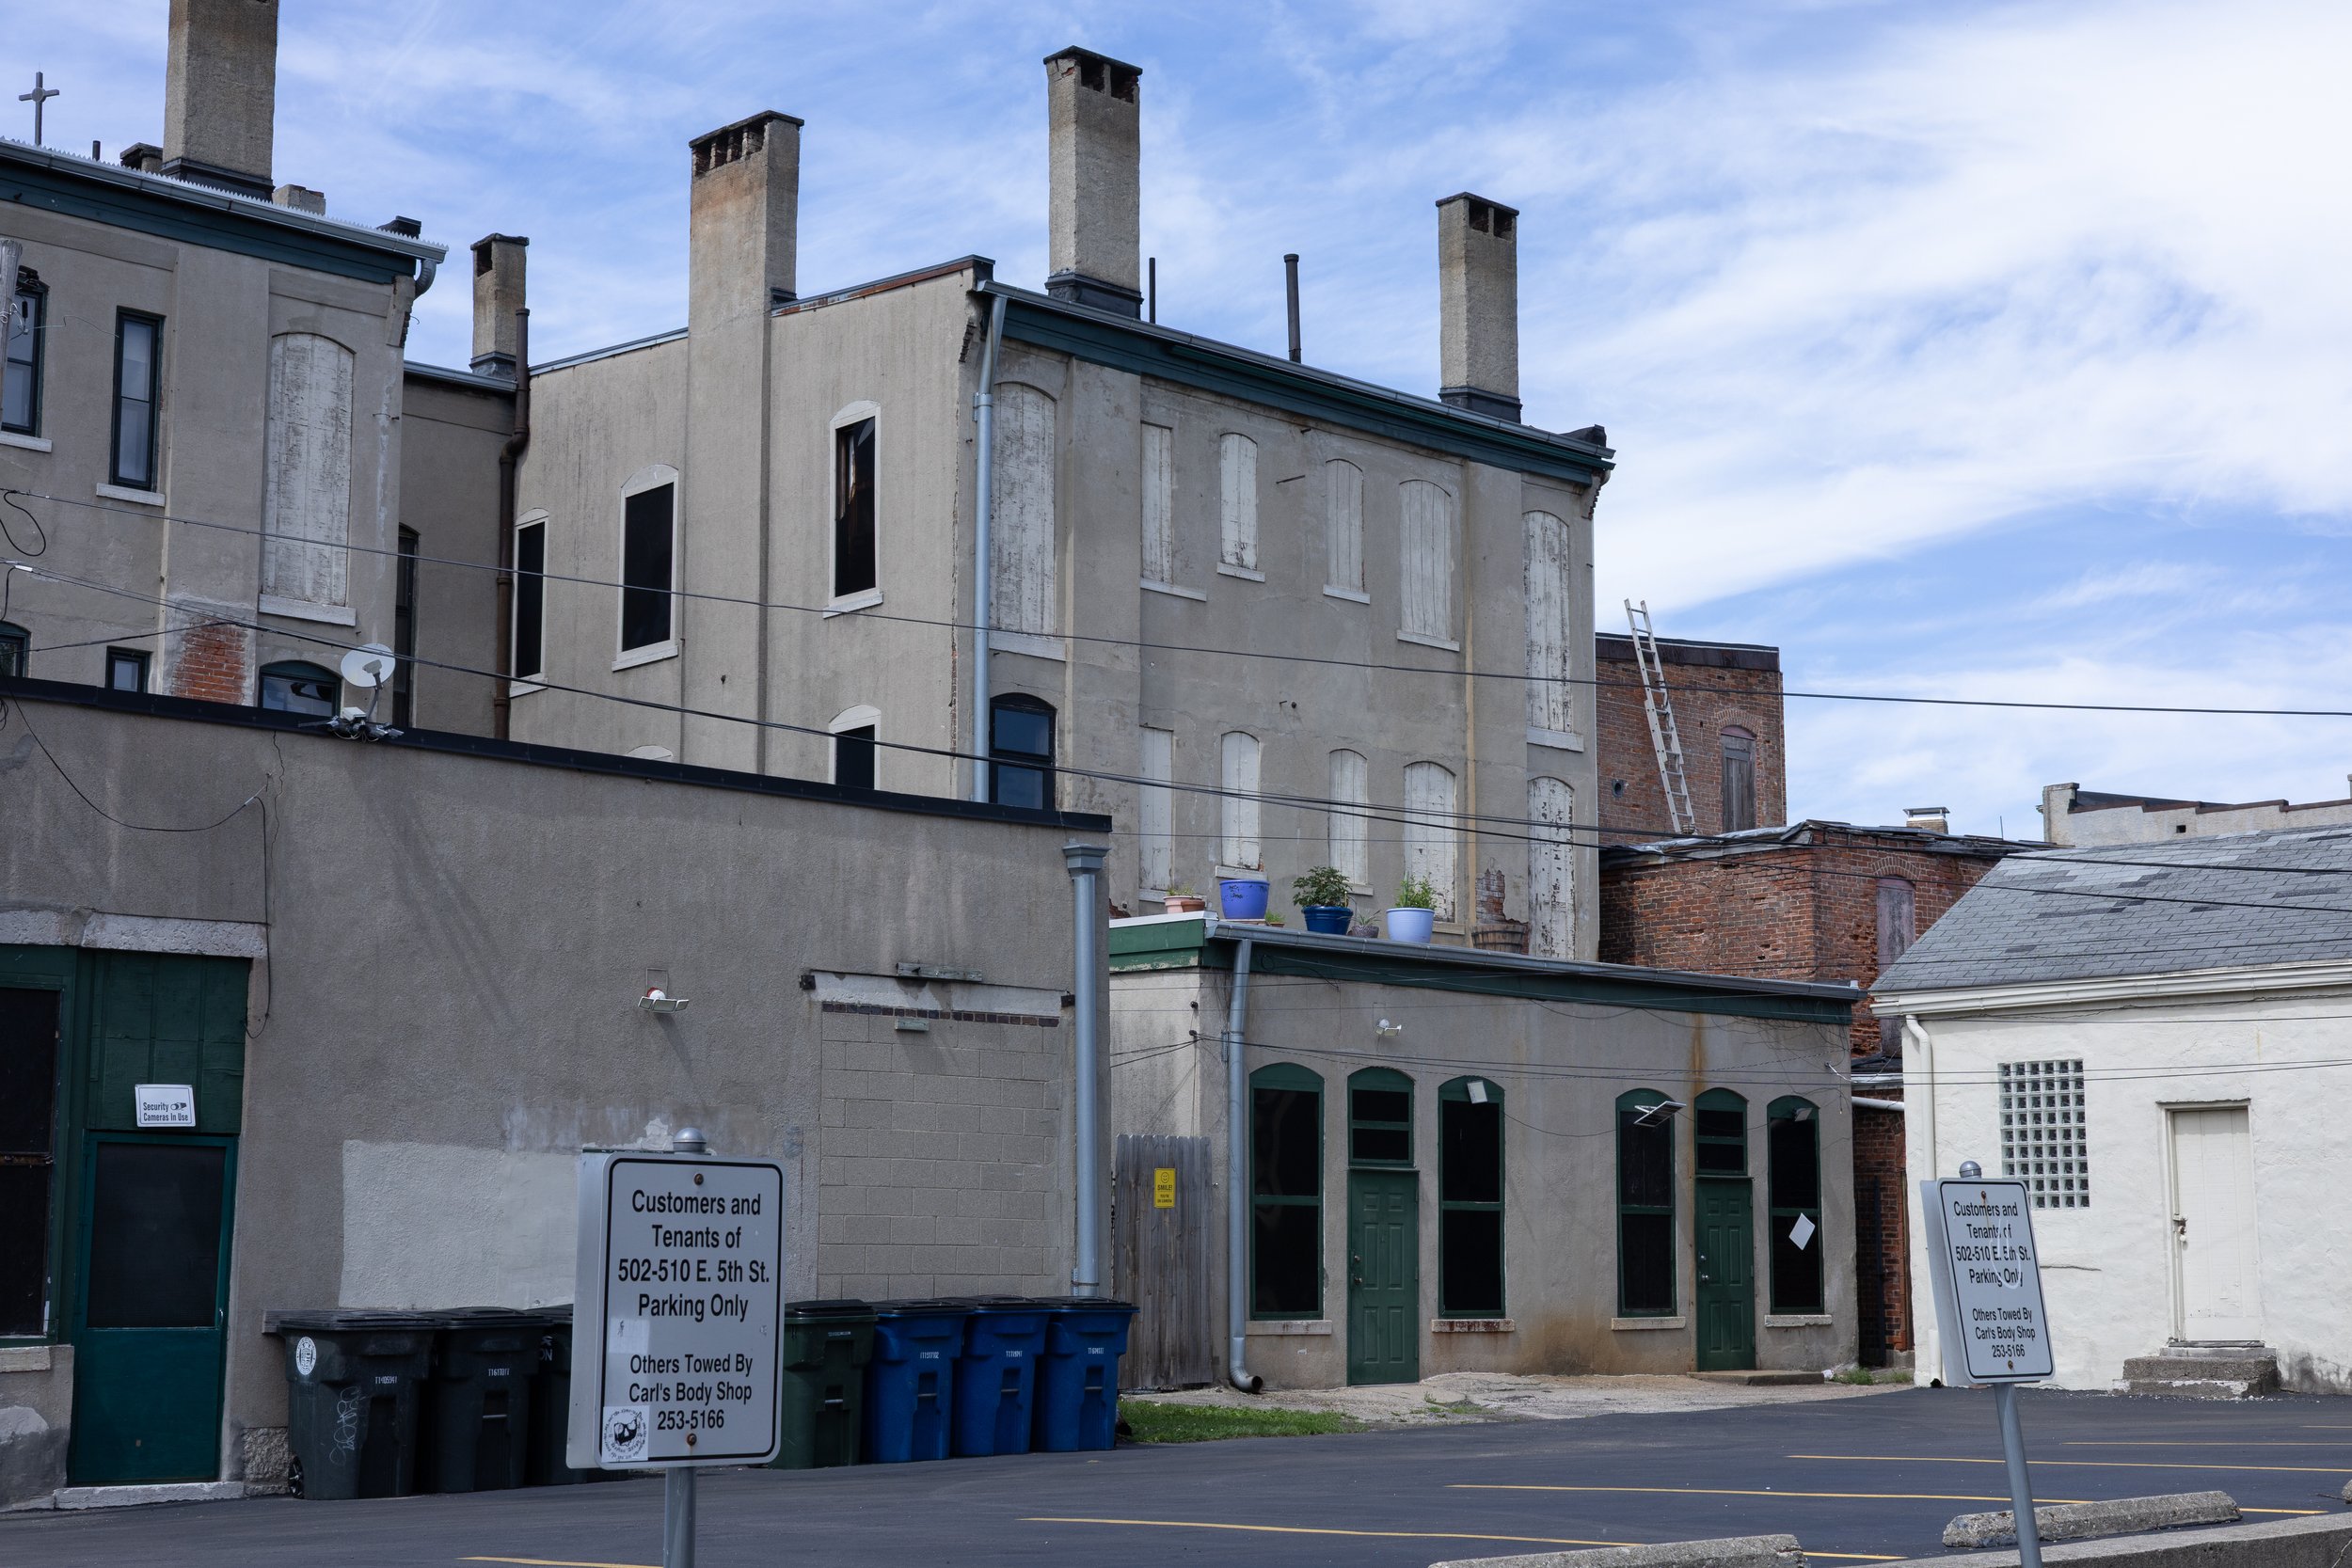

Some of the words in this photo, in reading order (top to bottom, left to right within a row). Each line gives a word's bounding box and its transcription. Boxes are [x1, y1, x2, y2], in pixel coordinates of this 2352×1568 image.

[143, 1102, 168, 1112] Security
[144, 1113, 168, 1121] Cameras
[171, 1113, 176, 1121] In
[178, 1113, 188, 1121] Use
[632, 1189, 725, 1215] Customers
[731, 1194, 761, 1215] and
[1953, 1200, 2000, 1217] Customers
[2002, 1202, 2018, 1216] and
[652, 1224, 720, 1248] Tenants
[724, 1226, 741, 1249] of
[1966, 1223, 2001, 1239] Tenants
[2003, 1224, 2011, 1239] of
[1955, 1246, 1991, 1261] 502-510
[1993, 1246, 2002, 1261] E.
[2003, 1245, 2017, 1260] 5th
[2018, 1245, 2031, 1260] St.
[618, 1259, 691, 1282] 502-510
[696, 1259, 711, 1283] E.
[717, 1260, 743, 1283] 5th
[749, 1260, 770, 1283] St.
[1969, 1268, 2002, 1287] Parking
[2004, 1268, 2023, 1287] Only
[639, 1293, 705, 1323] Parking
[710, 1292, 749, 1323] Only
[1972, 1308, 1997, 1323] Others
[1998, 1307, 2021, 1322] Towed
[2023, 1307, 2032, 1323] By
[1975, 1326, 1996, 1340] Carl's
[1997, 1326, 2016, 1341] Body
[2017, 1325, 2036, 1341] Shop
[1992, 1344, 2025, 1358] 253-5166
[630, 1354, 680, 1374] Others
[685, 1354, 731, 1373] Towed
[736, 1354, 753, 1377] By
[628, 1383, 671, 1403] Carl's
[675, 1382, 712, 1405] Body
[717, 1381, 753, 1405] Shop
[657, 1409, 724, 1431] 253-5166
